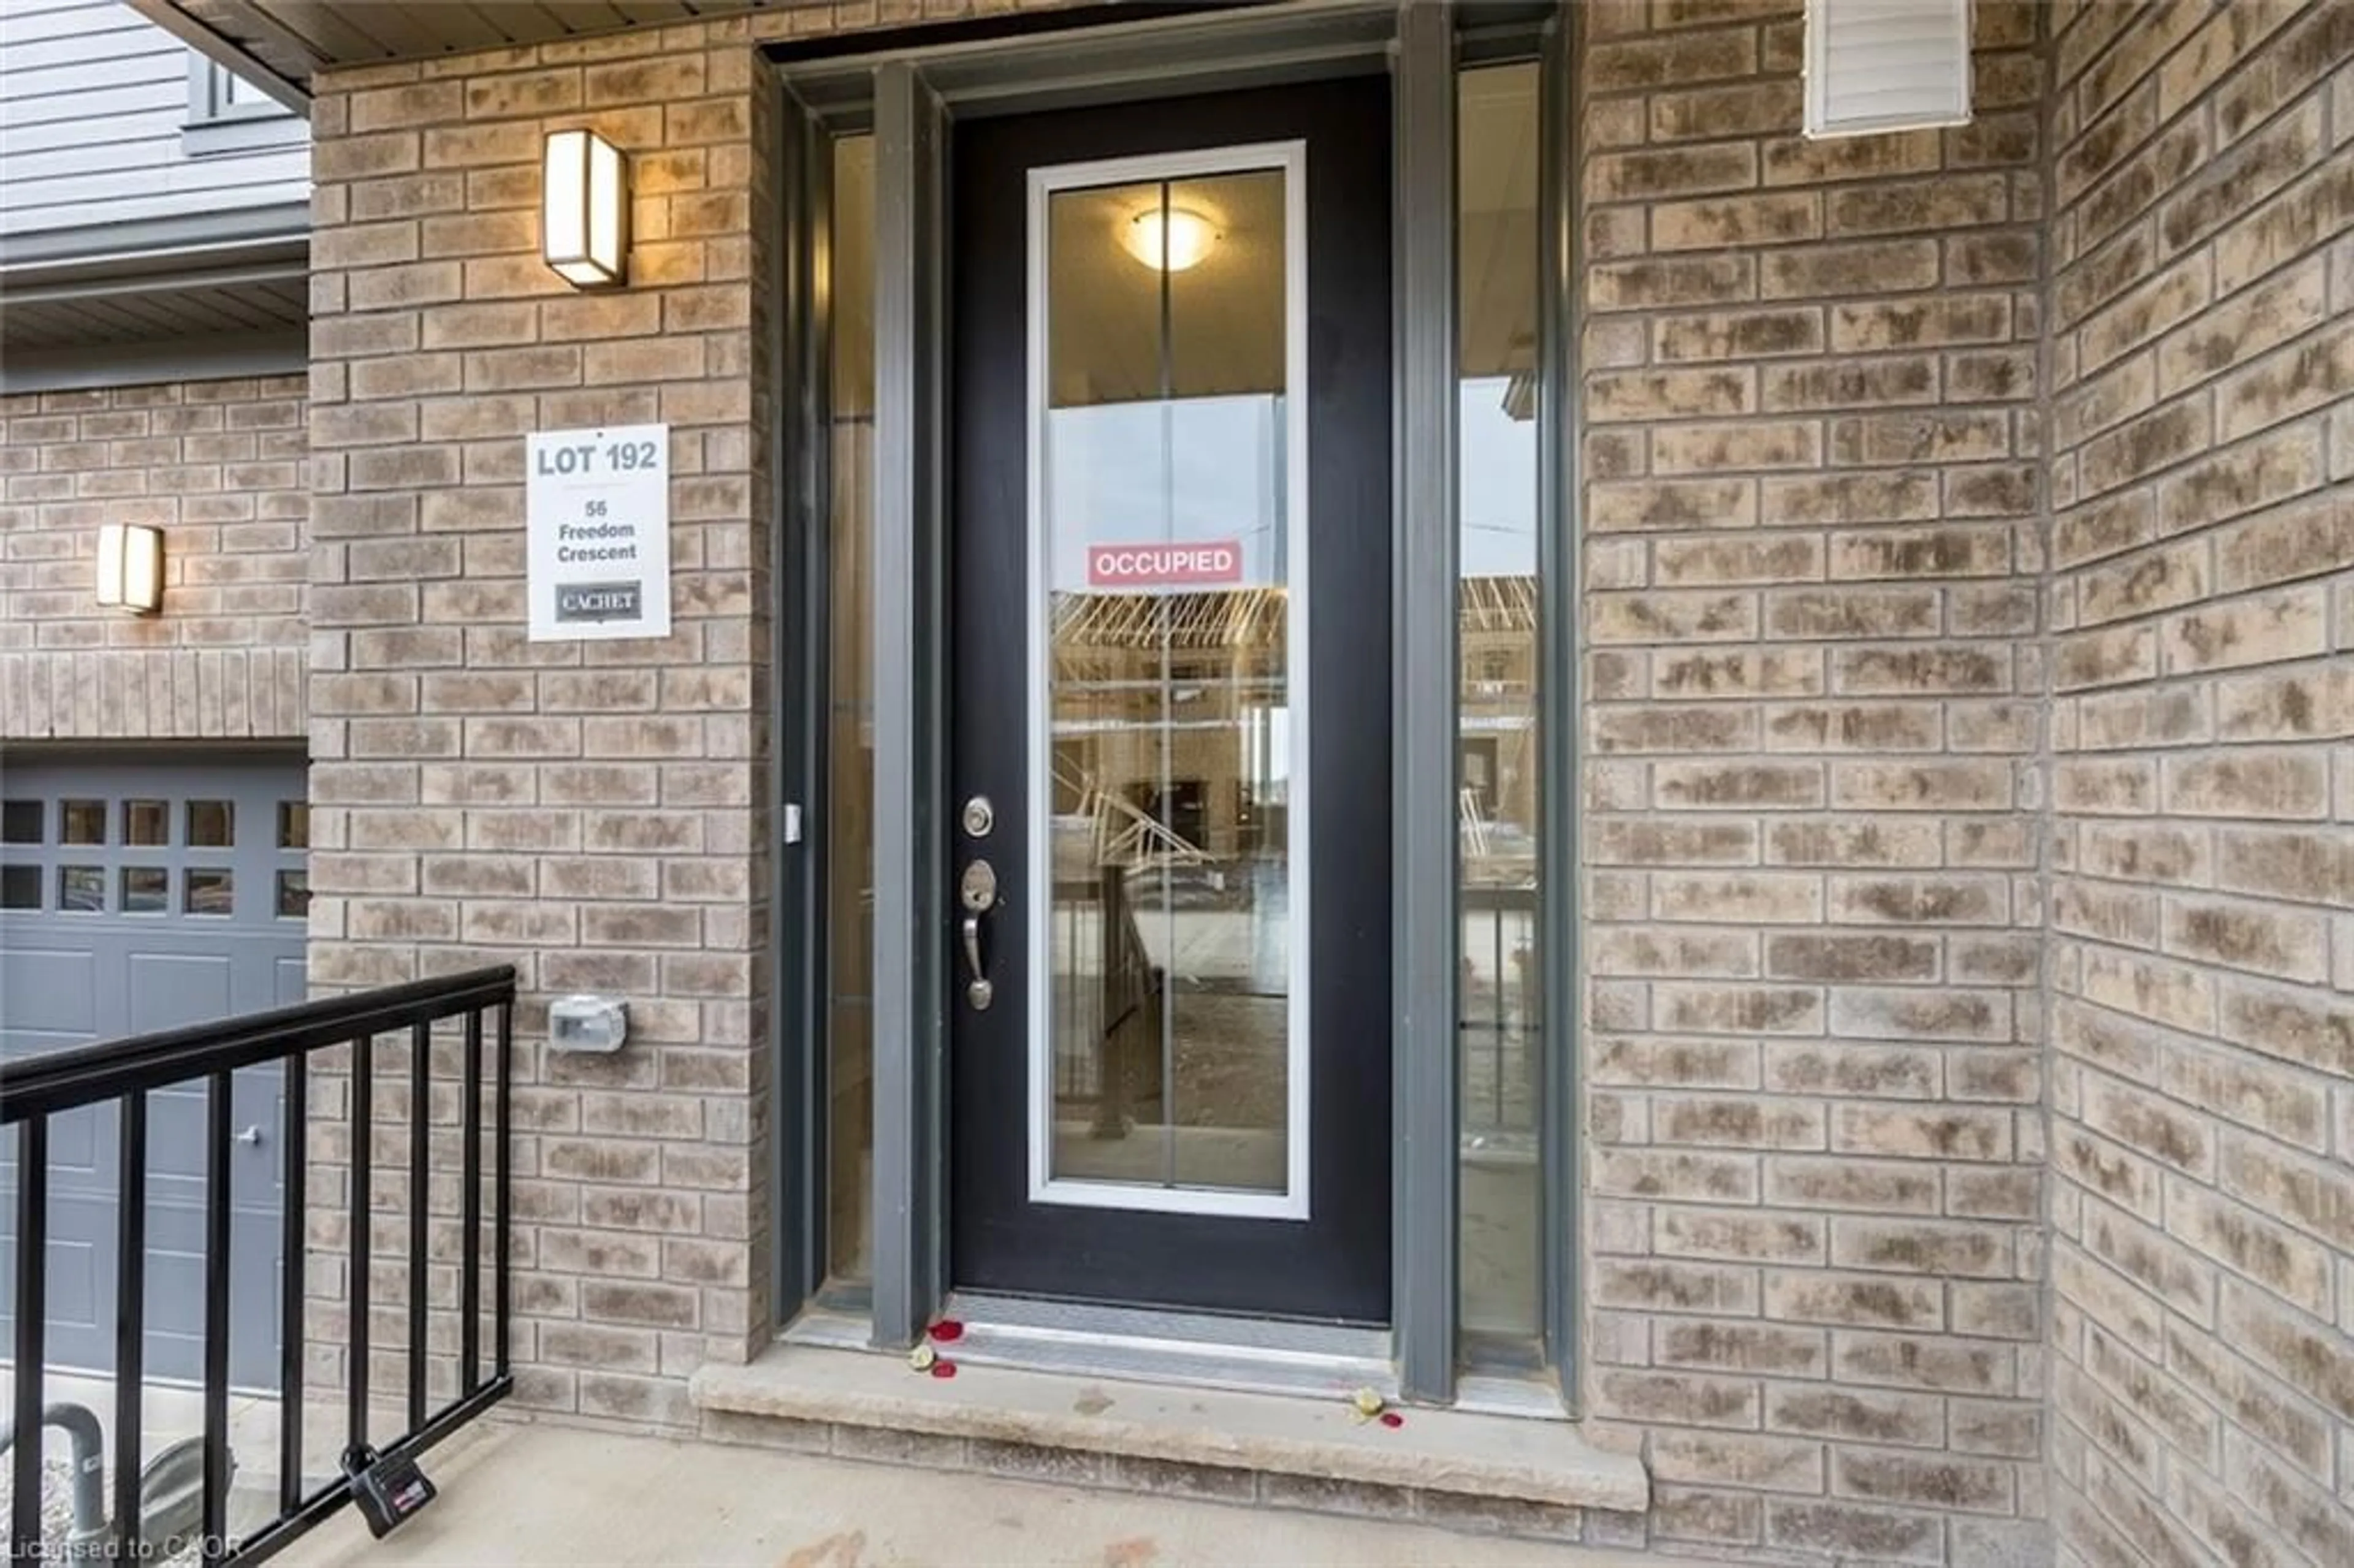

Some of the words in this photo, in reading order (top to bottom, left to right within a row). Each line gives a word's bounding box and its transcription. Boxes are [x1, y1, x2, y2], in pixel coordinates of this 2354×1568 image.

[538, 446, 595, 474] LOT
[607, 441, 657, 471] 192
[558, 523, 635, 540] Freedom
[557, 544, 637, 562] Crescent
[1095, 549, 1233, 576] OCCUPIED
[562, 592, 632, 611] CACHET
